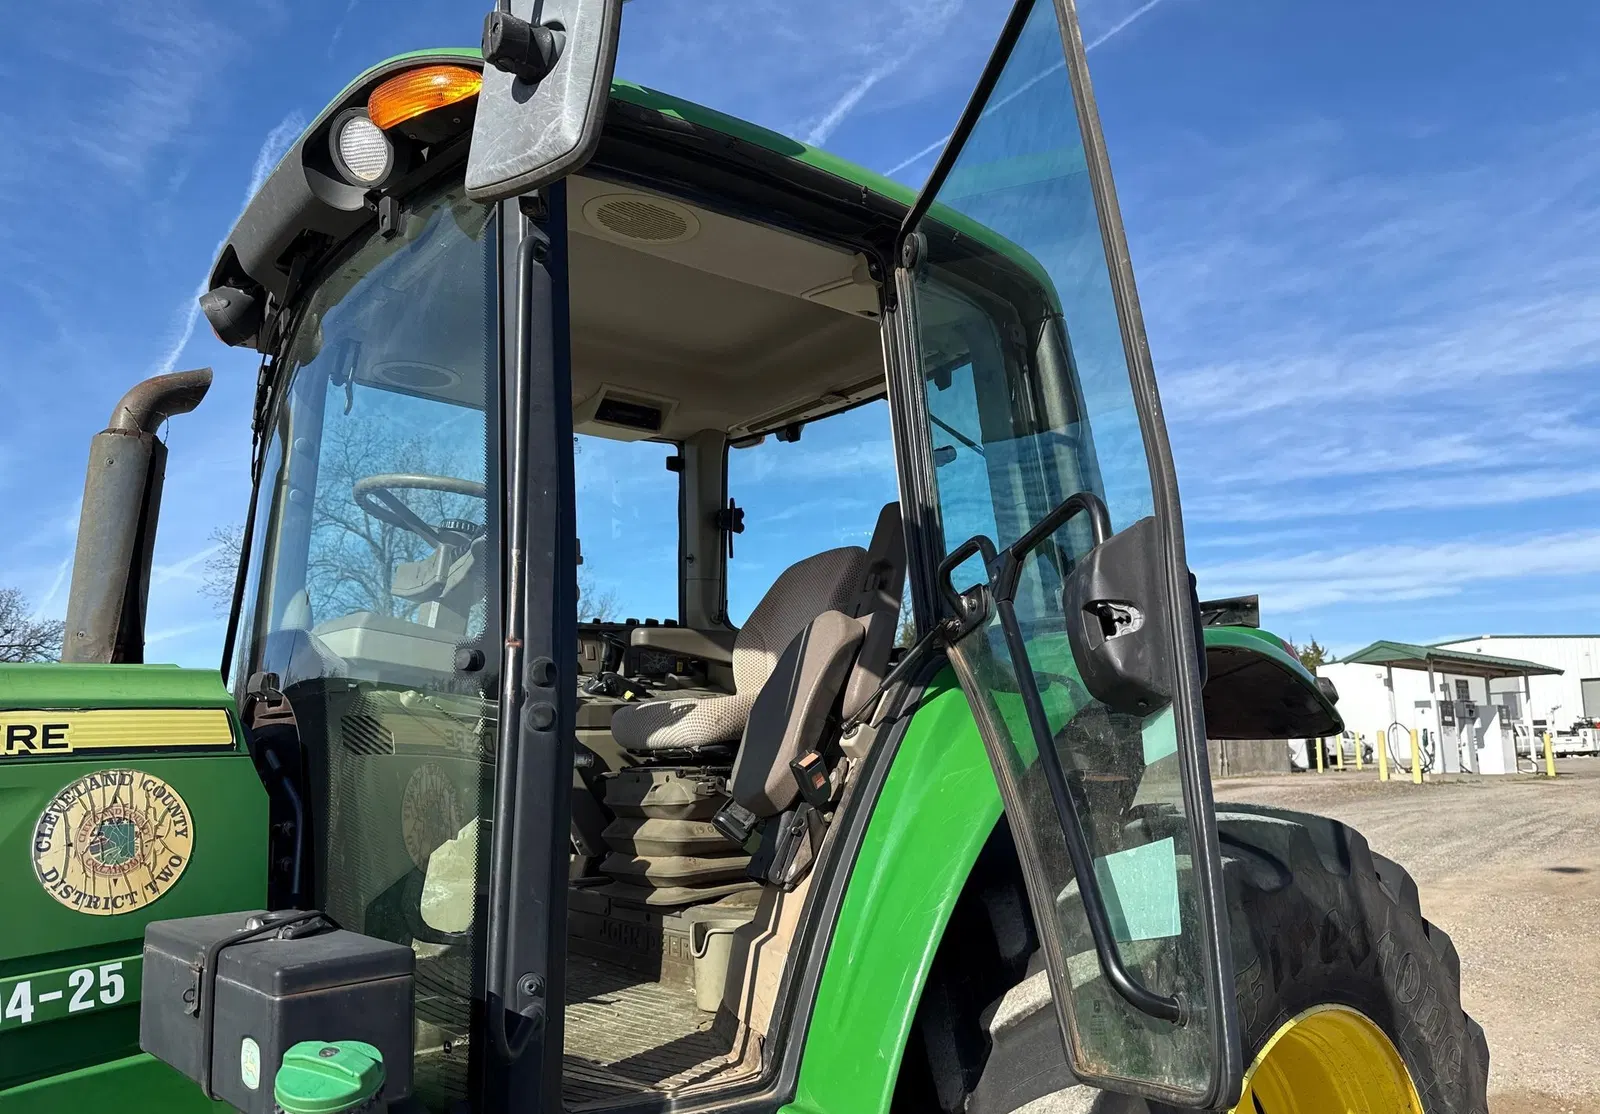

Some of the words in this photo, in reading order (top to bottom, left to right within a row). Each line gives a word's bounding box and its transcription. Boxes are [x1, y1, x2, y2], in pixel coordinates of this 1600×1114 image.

[0, 724, 69, 750] RE
[36, 773, 133, 853] CLEVELAND
[143, 779, 188, 838] COUNTY
[42, 866, 137, 910] DISTRICT
[144, 855, 183, 895] TWO
[645, 929, 694, 960] DEER
[0, 962, 125, 1024] 4-25
